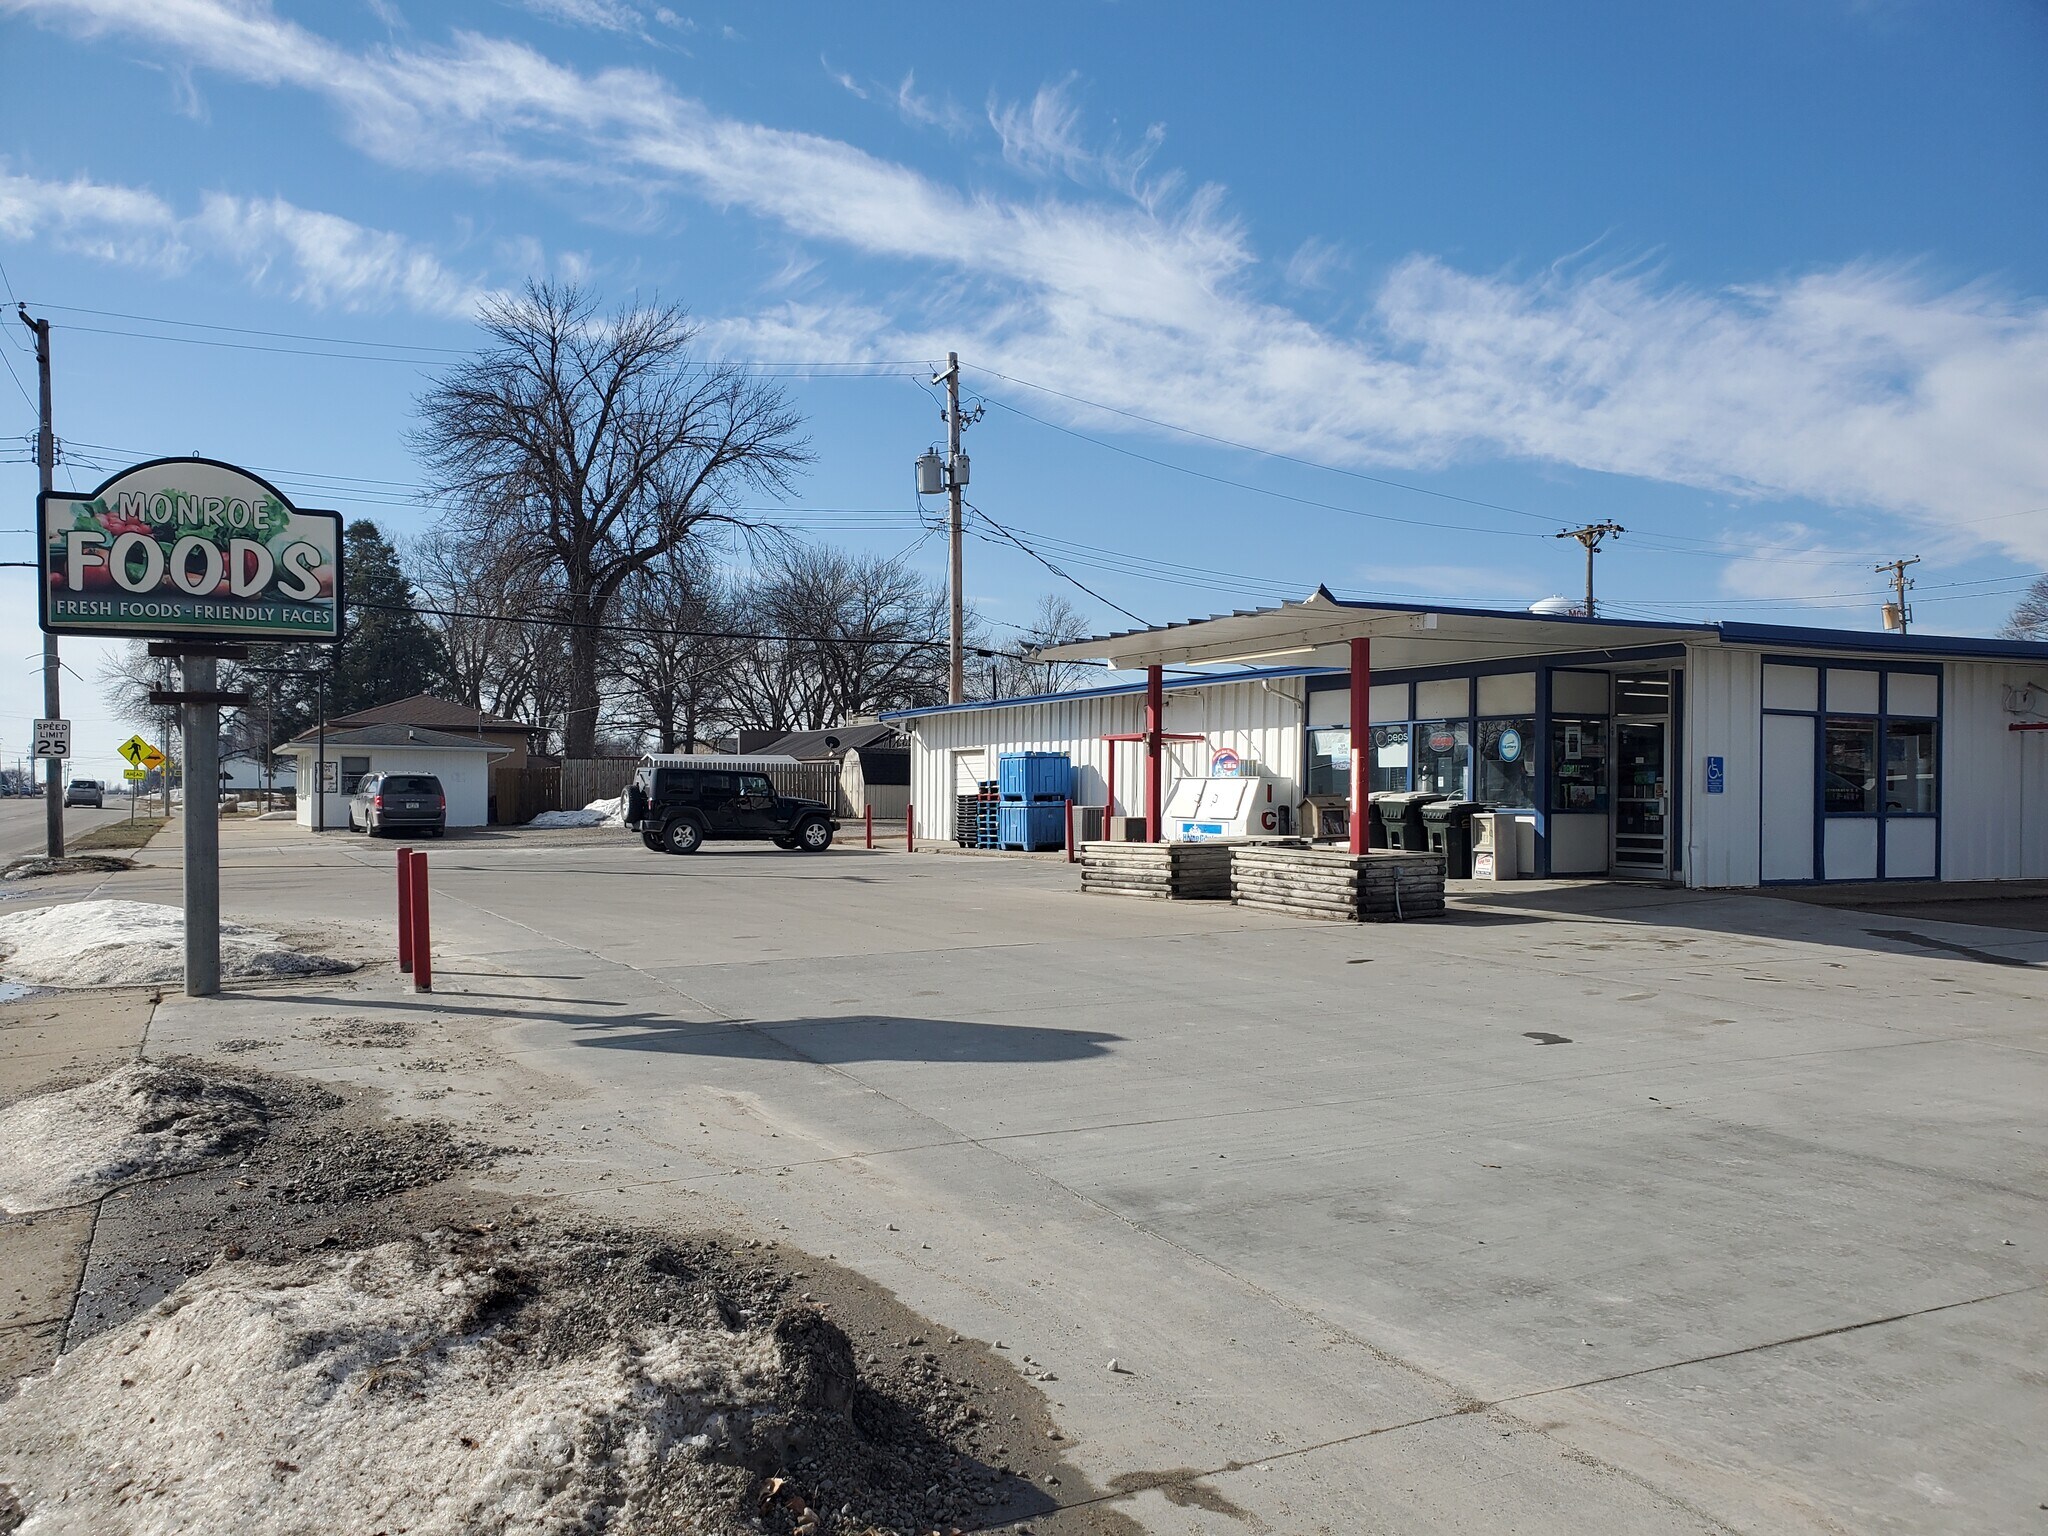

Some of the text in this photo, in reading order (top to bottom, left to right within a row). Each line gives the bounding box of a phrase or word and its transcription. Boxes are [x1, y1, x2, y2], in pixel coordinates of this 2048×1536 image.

[118, 491, 270, 530] MONROE
[66, 530, 323, 601] FOODS
[56, 600, 112, 615] FRESH
[119, 602, 181, 618] FOODS
[194, 605, 275, 621] FRIENDLY
[282, 608, 330, 624] FACES
[37, 723, 68, 731] SPEED
[40, 731, 64, 739] LIMIT
[37, 740, 67, 755] 25
[1387, 732, 1409, 744] peps
[1261, 783, 1277, 831] IC
